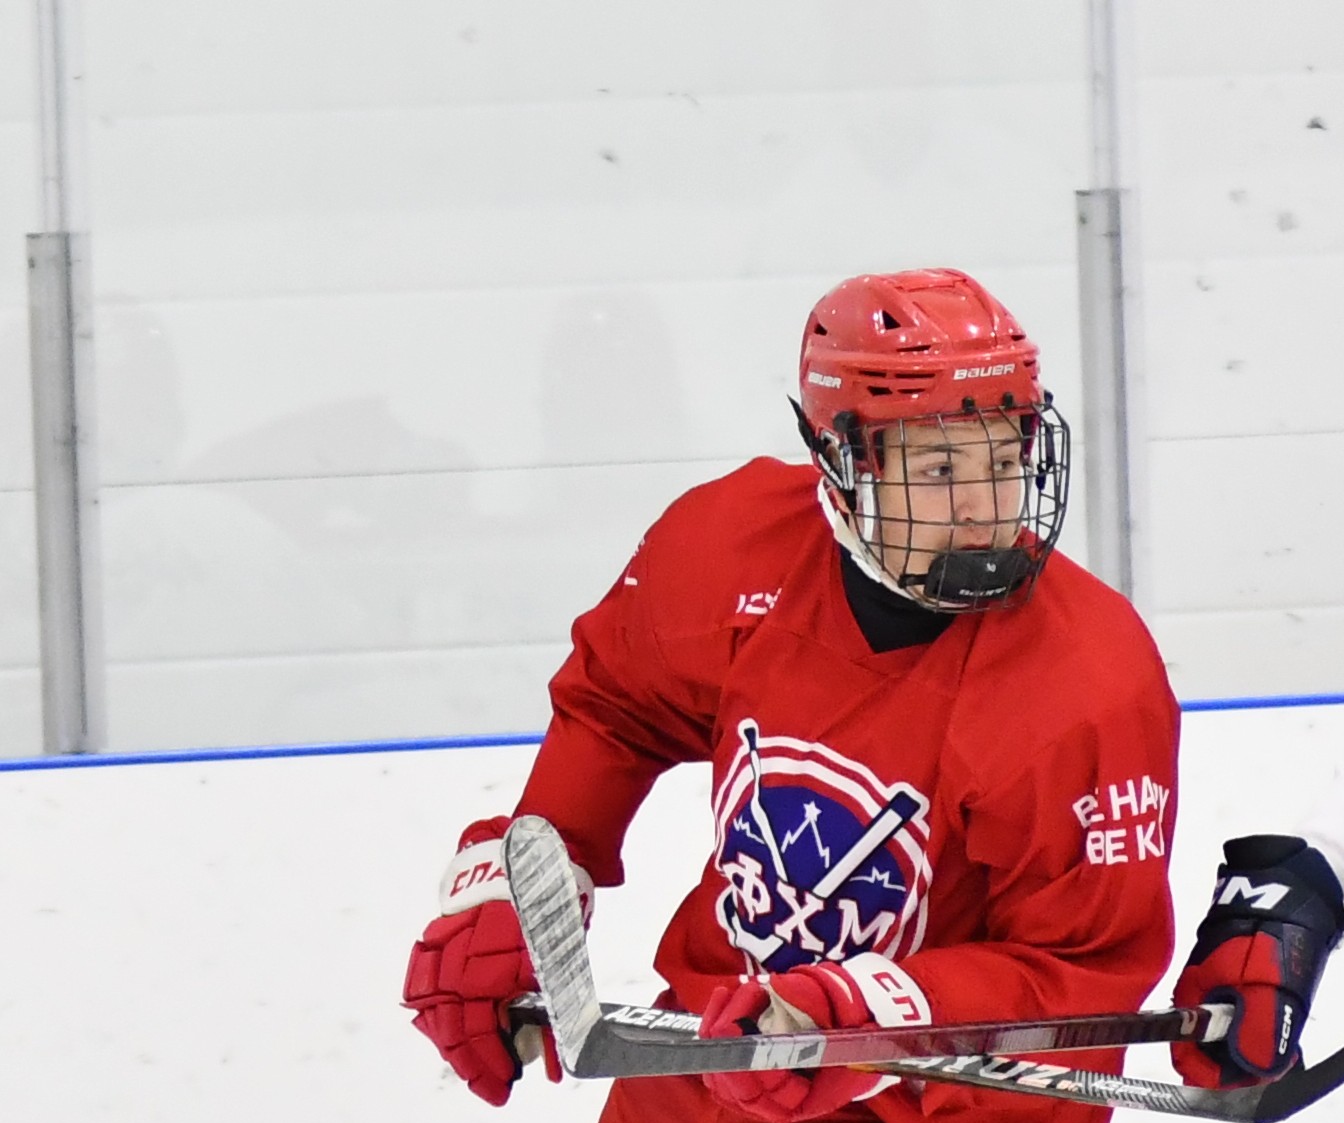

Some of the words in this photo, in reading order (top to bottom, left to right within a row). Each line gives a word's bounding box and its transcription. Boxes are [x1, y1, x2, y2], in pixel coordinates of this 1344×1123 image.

[954, 363, 1016, 380] BAUER
[1086, 828, 1129, 865] BE
[1212, 876, 1291, 910] M
[603, 1006, 663, 1026] ACE
[1278, 1004, 1293, 1055] CCM
